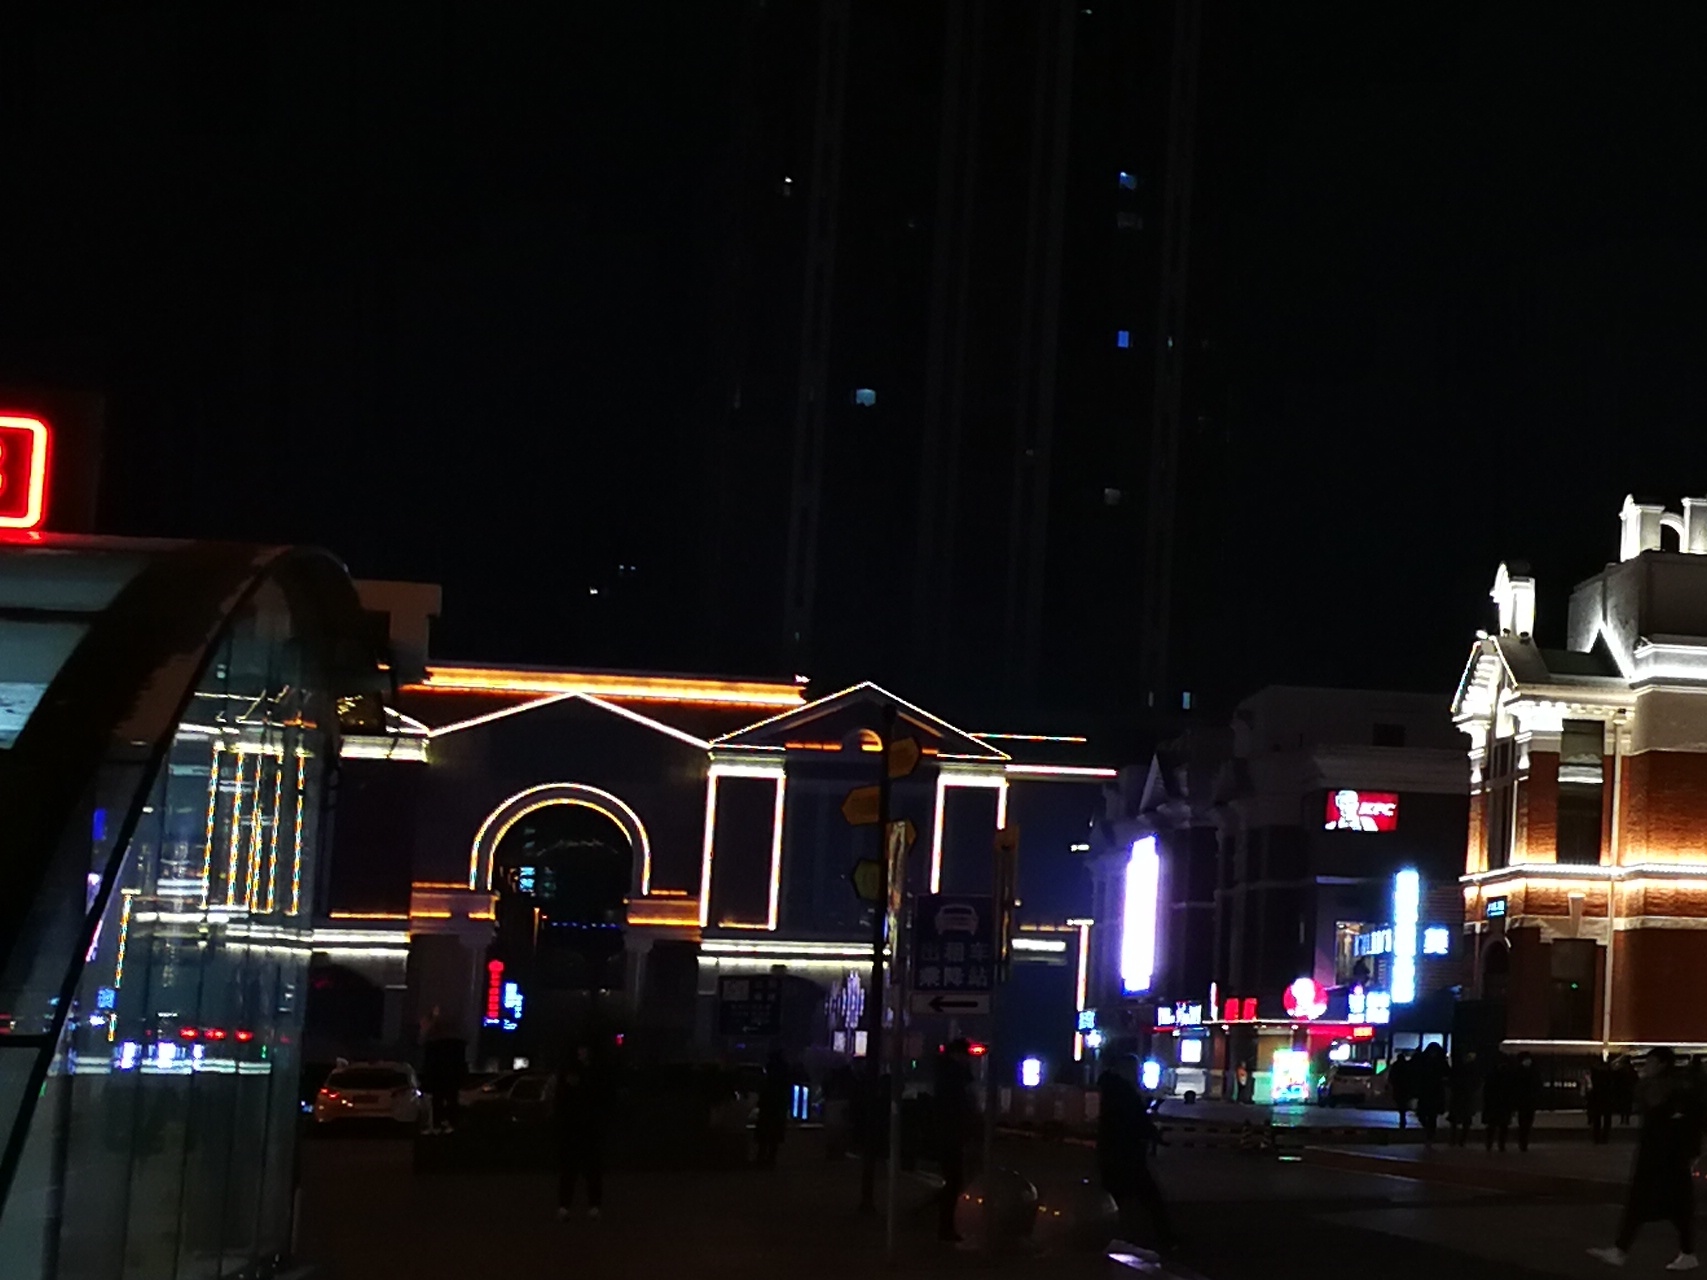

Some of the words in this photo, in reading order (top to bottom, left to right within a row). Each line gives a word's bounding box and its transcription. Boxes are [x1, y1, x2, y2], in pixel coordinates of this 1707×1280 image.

[1358, 801, 1397, 817] KFC
[919, 941, 990, 963] 出租车
